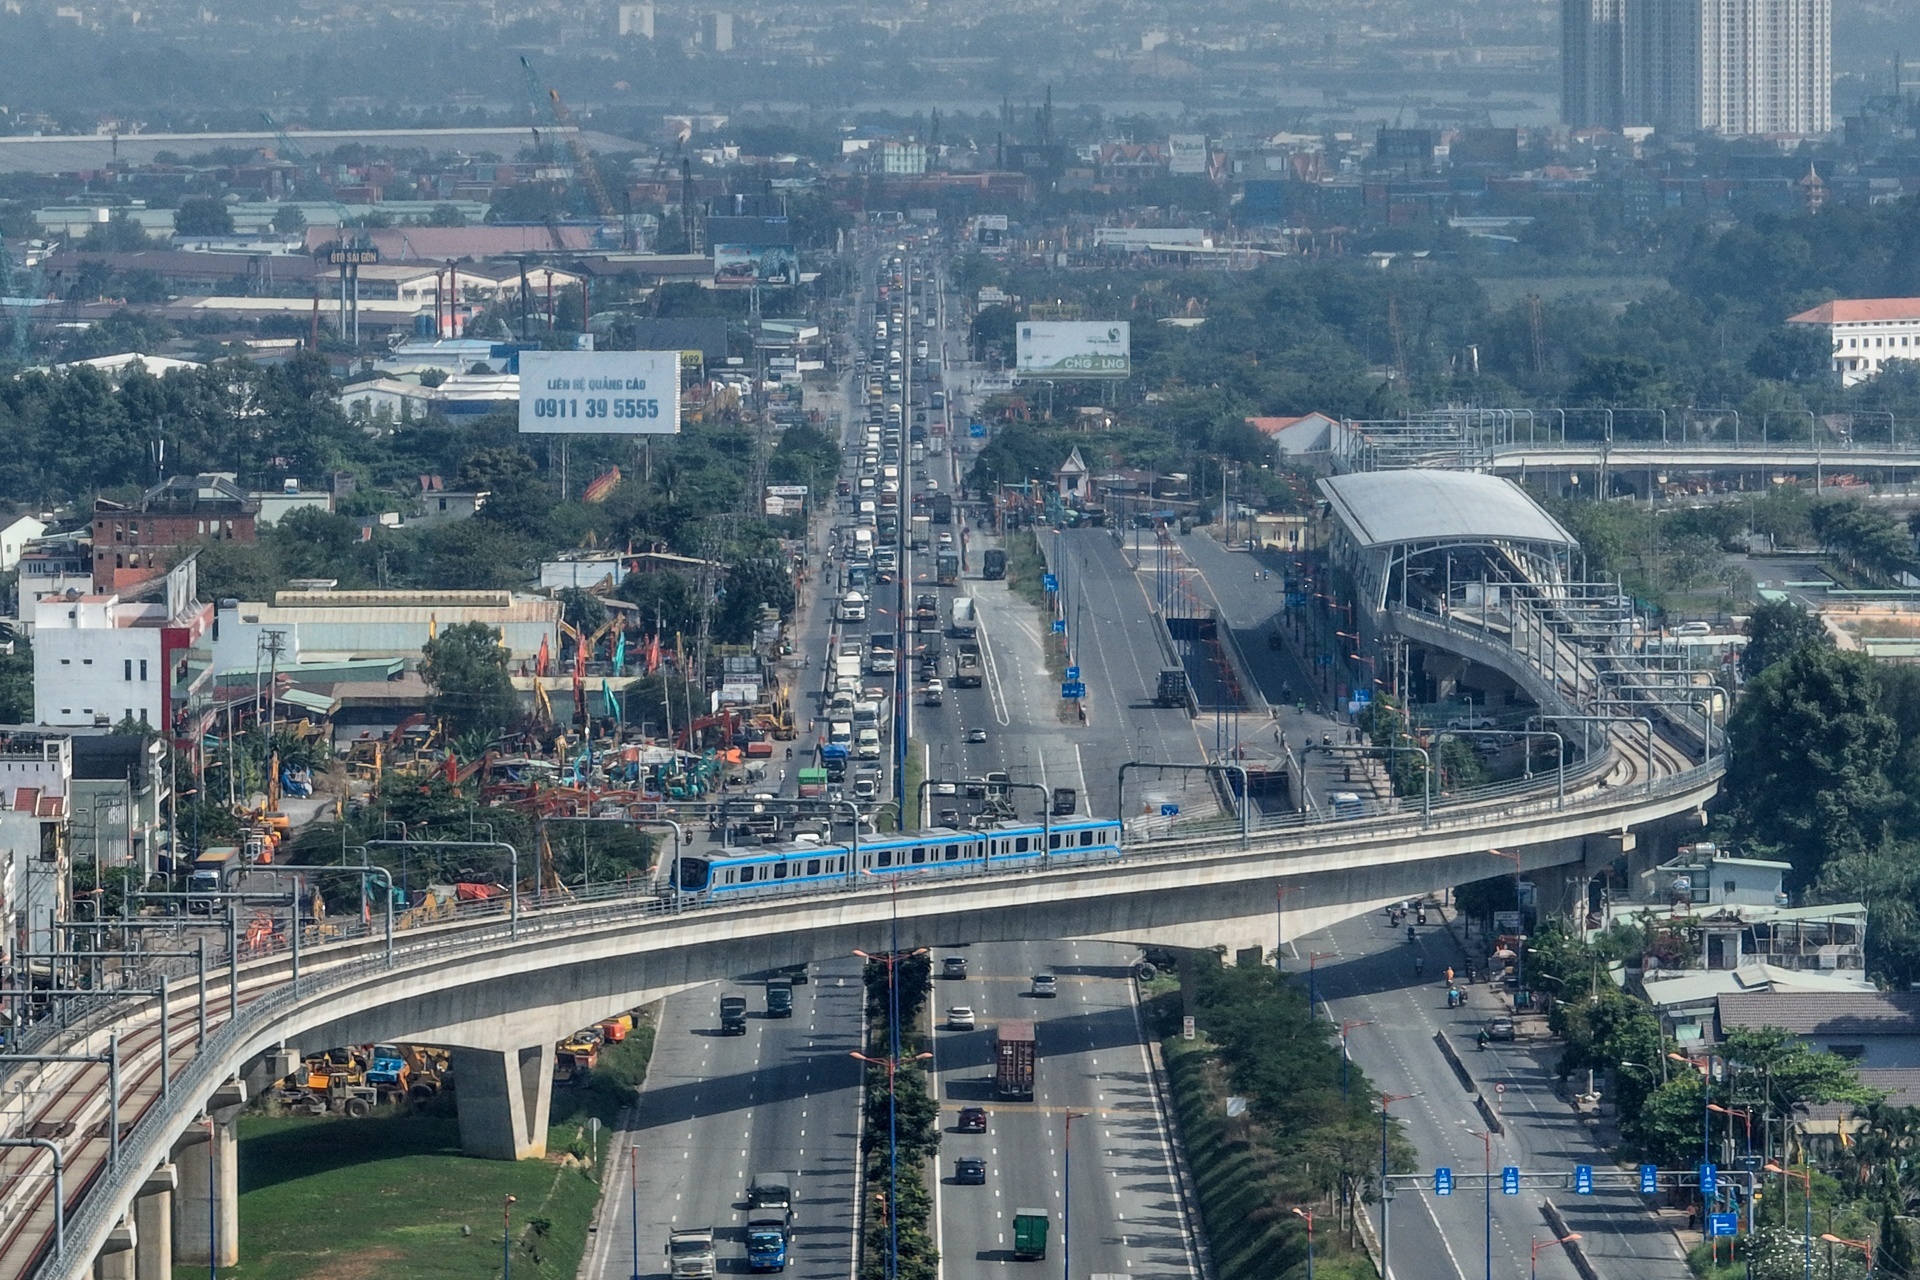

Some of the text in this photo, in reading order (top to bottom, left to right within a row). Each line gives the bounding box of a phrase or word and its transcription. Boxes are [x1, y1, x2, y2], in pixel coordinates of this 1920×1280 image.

[1065, 359, 1092, 369] CNG
[1102, 359, 1125, 369] LNG
[547, 376, 646, 392] LIÊN HỆ QUẢNG CÁO
[535, 398, 659, 418] 0911 39 5555
